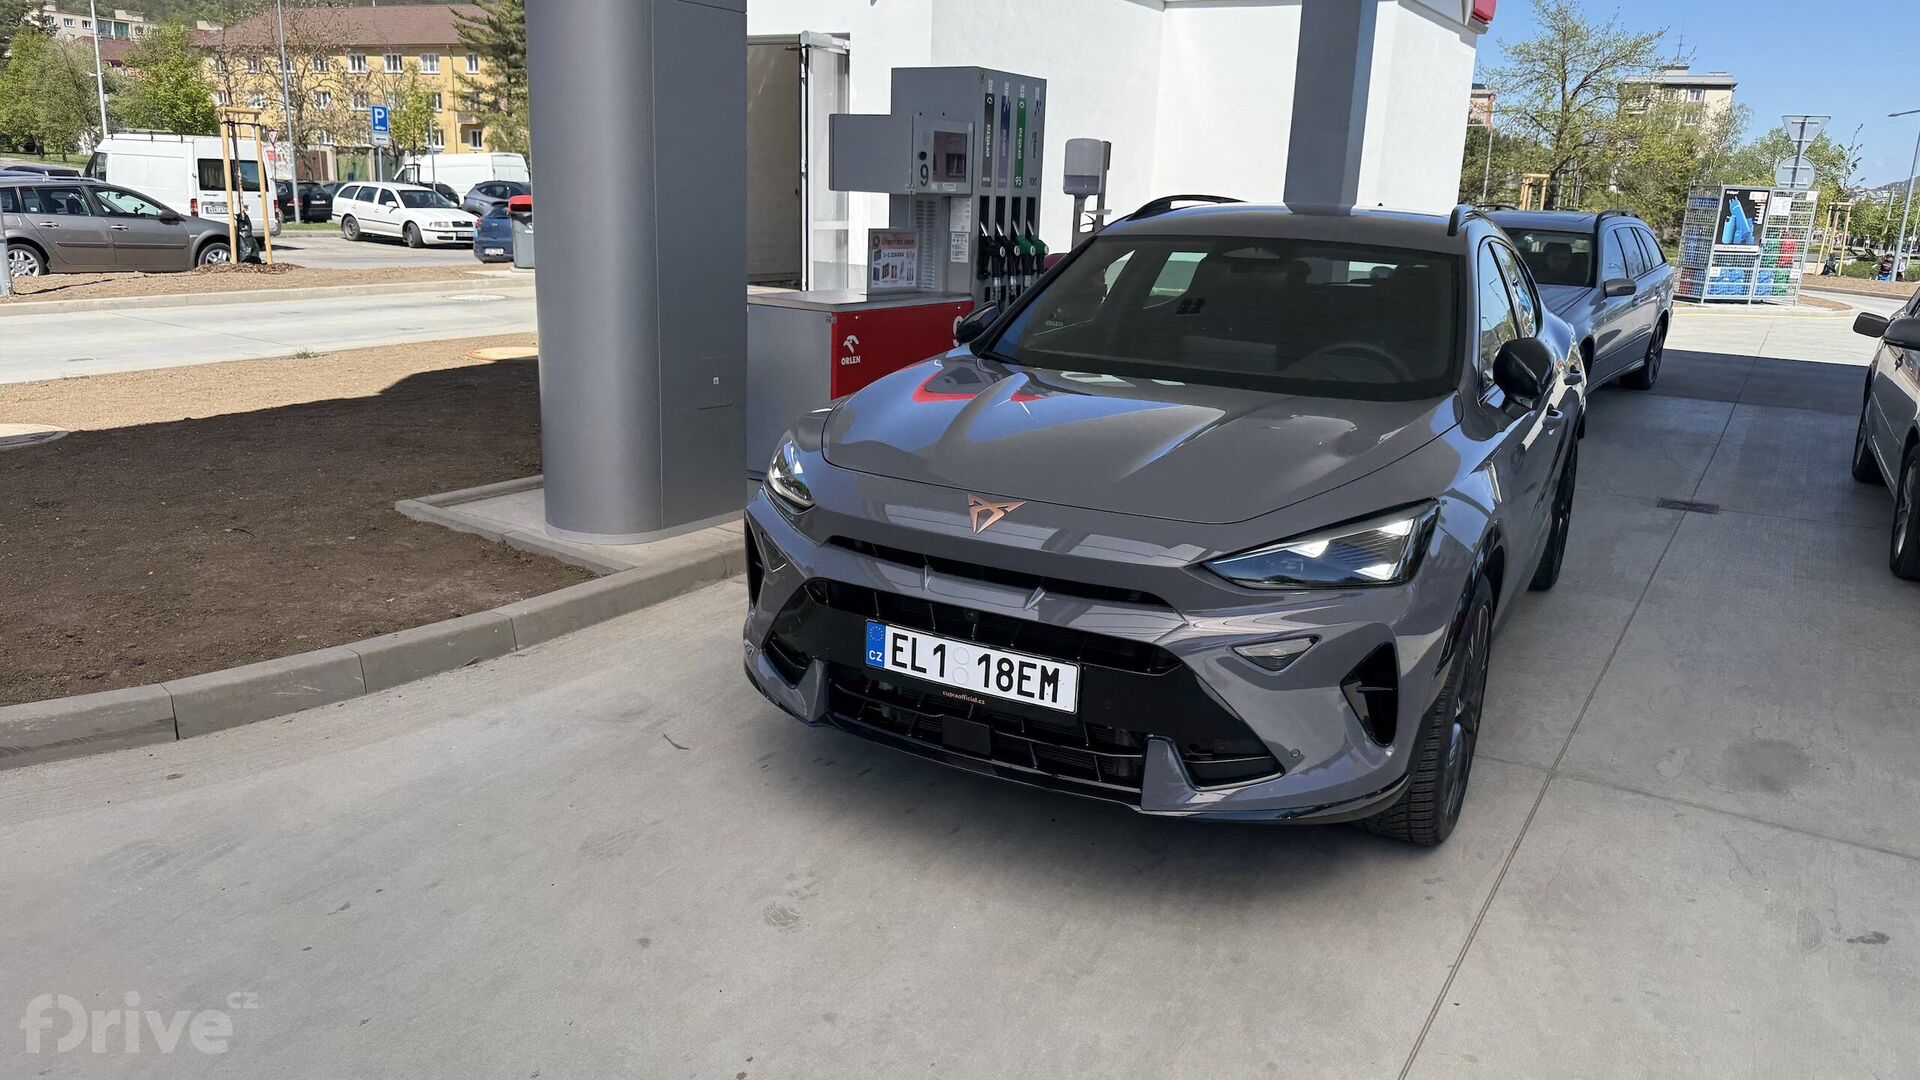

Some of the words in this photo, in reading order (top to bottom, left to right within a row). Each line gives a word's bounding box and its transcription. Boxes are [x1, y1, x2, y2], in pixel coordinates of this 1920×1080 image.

[374, 107, 385, 124] P
[920, 163, 929, 187] 9
[1015, 176, 1022, 186] 95
[840, 354, 861, 366] ORLEN
[868, 650, 883, 662] CZ
[891, 632, 946, 678] EL1
[977, 653, 1060, 704] 18EM
[943, 690, 986, 705] cupraofficial.cz
